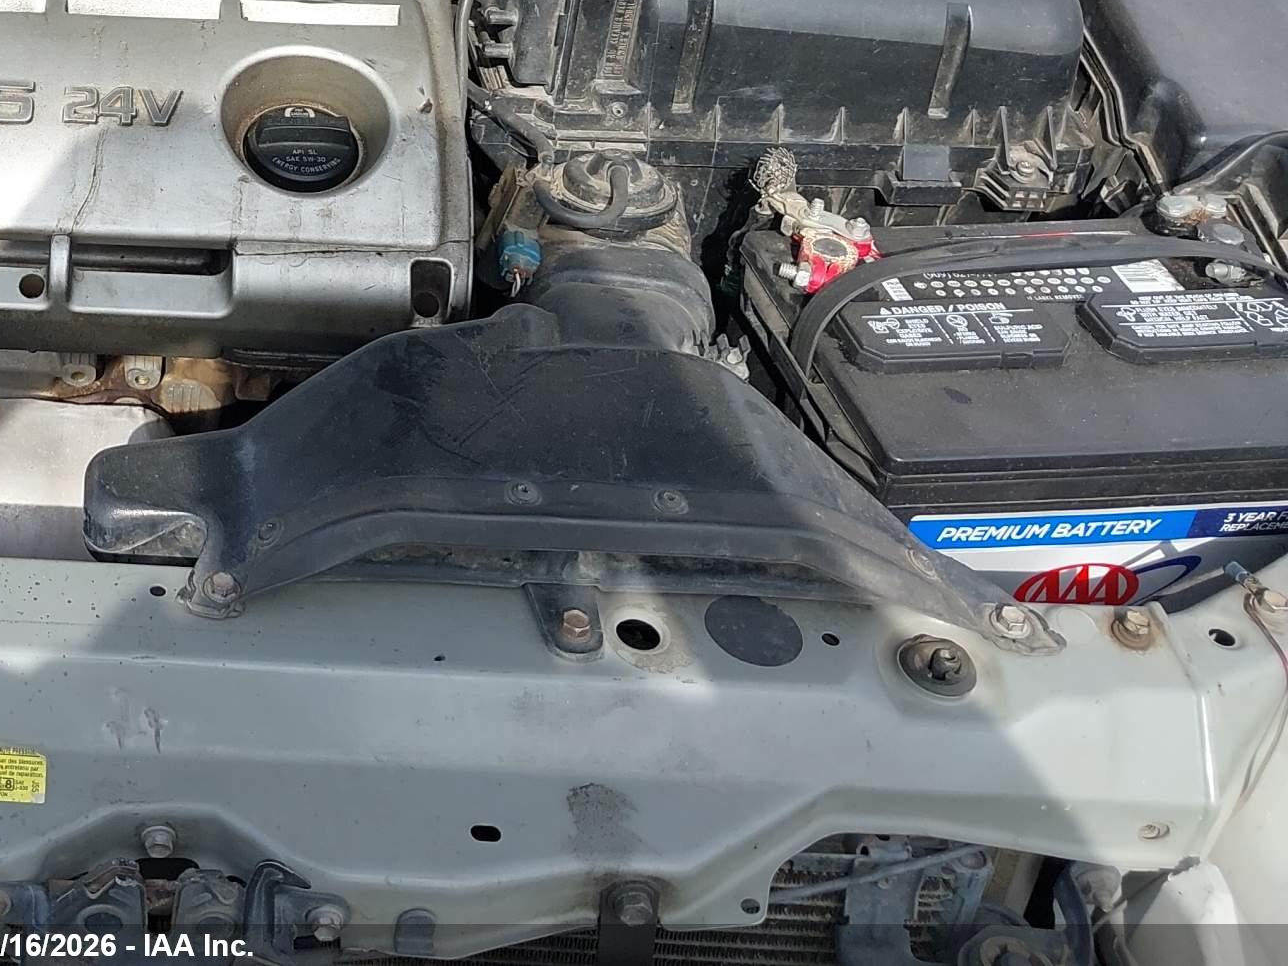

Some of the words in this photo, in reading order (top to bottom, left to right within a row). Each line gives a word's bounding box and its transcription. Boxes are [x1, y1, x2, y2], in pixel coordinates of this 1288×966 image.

[61, 85, 184, 127] 24V
[272, 157, 298, 171] ENERGY
[300, 157, 342, 173] CONSERVING
[891, 304, 946, 315] DANGER
[955, 302, 1007, 312] POISON
[1223, 512, 1237, 523] 3
[1237, 511, 1277, 523] YEAR
[937, 522, 1054, 543] PREMIUM
[1053, 518, 1164, 538] BATTERY
[1014, 563, 1140, 605] AAA
